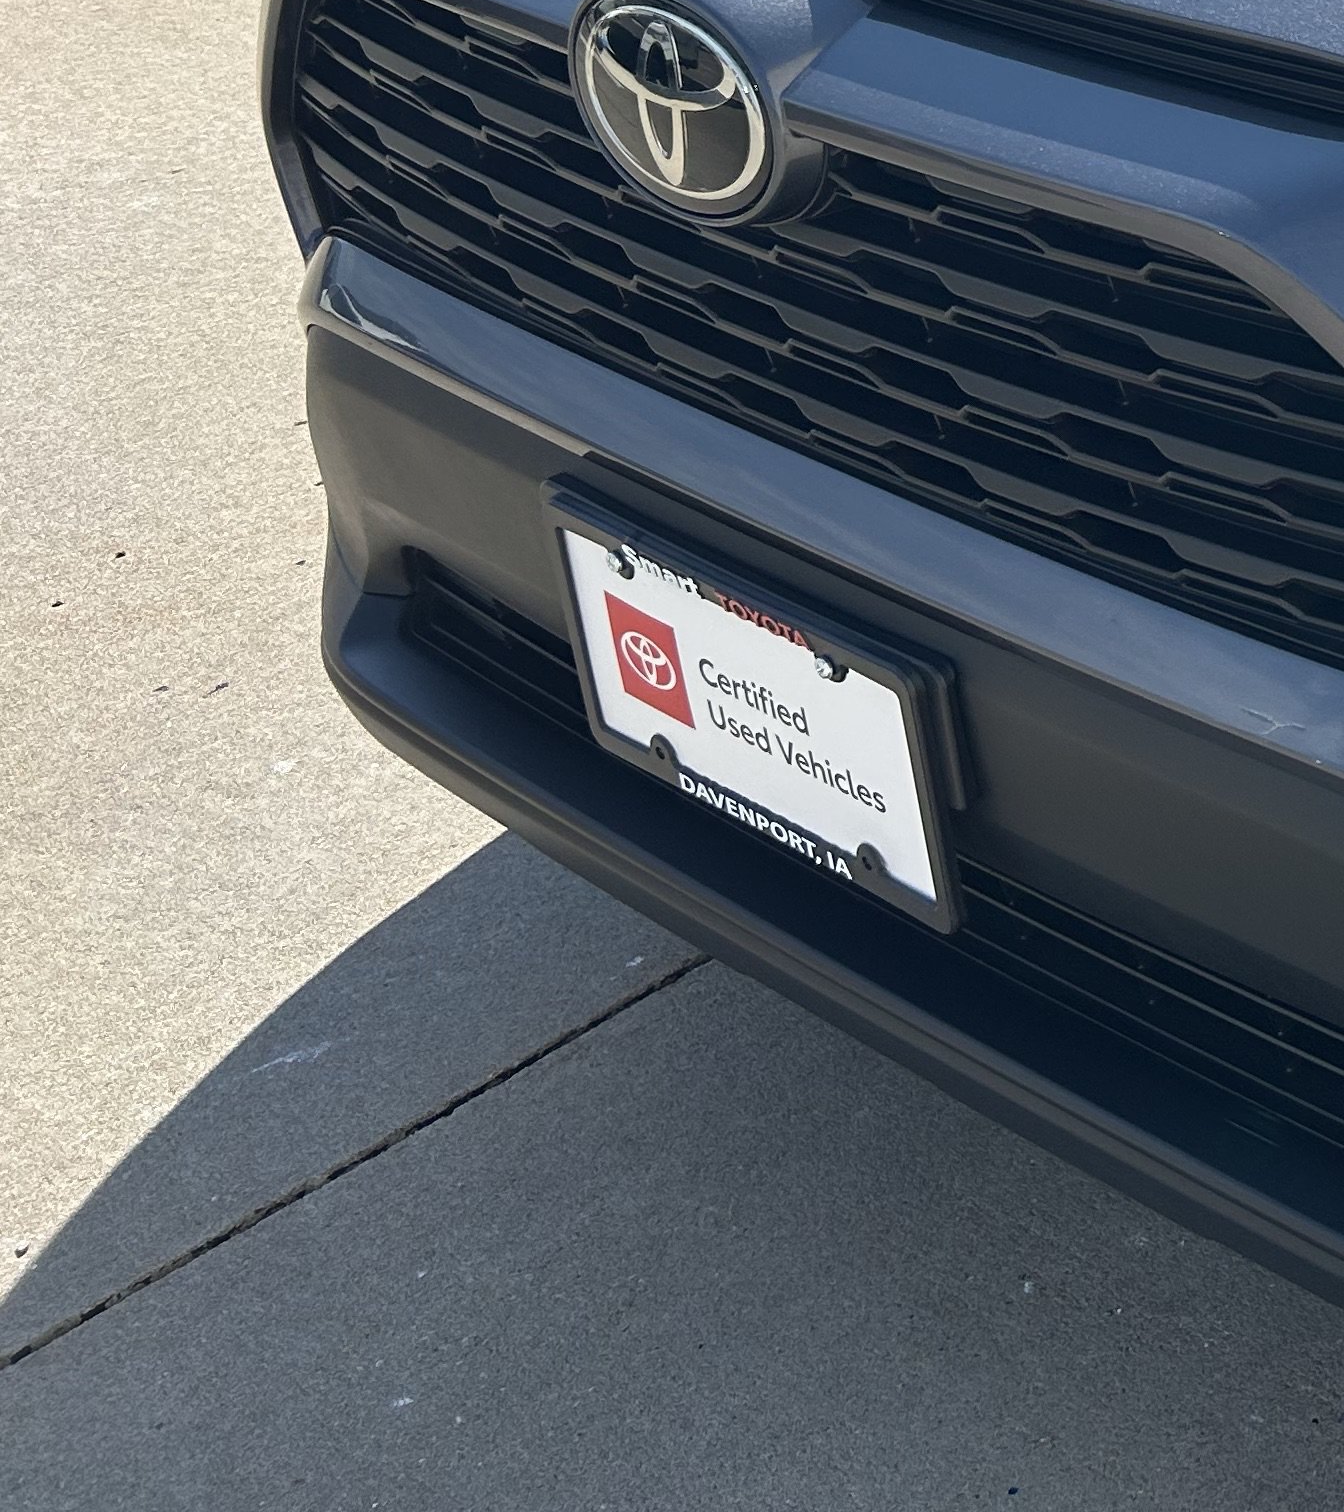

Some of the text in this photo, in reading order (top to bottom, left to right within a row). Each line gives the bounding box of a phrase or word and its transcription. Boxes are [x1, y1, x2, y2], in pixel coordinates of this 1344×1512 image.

[621, 543, 811, 650] Smart TOYOTA
[698, 658, 811, 737] Certified
[706, 698, 887, 814] Used Vehicles
[678, 772, 853, 881] DAVENPORT, IA
